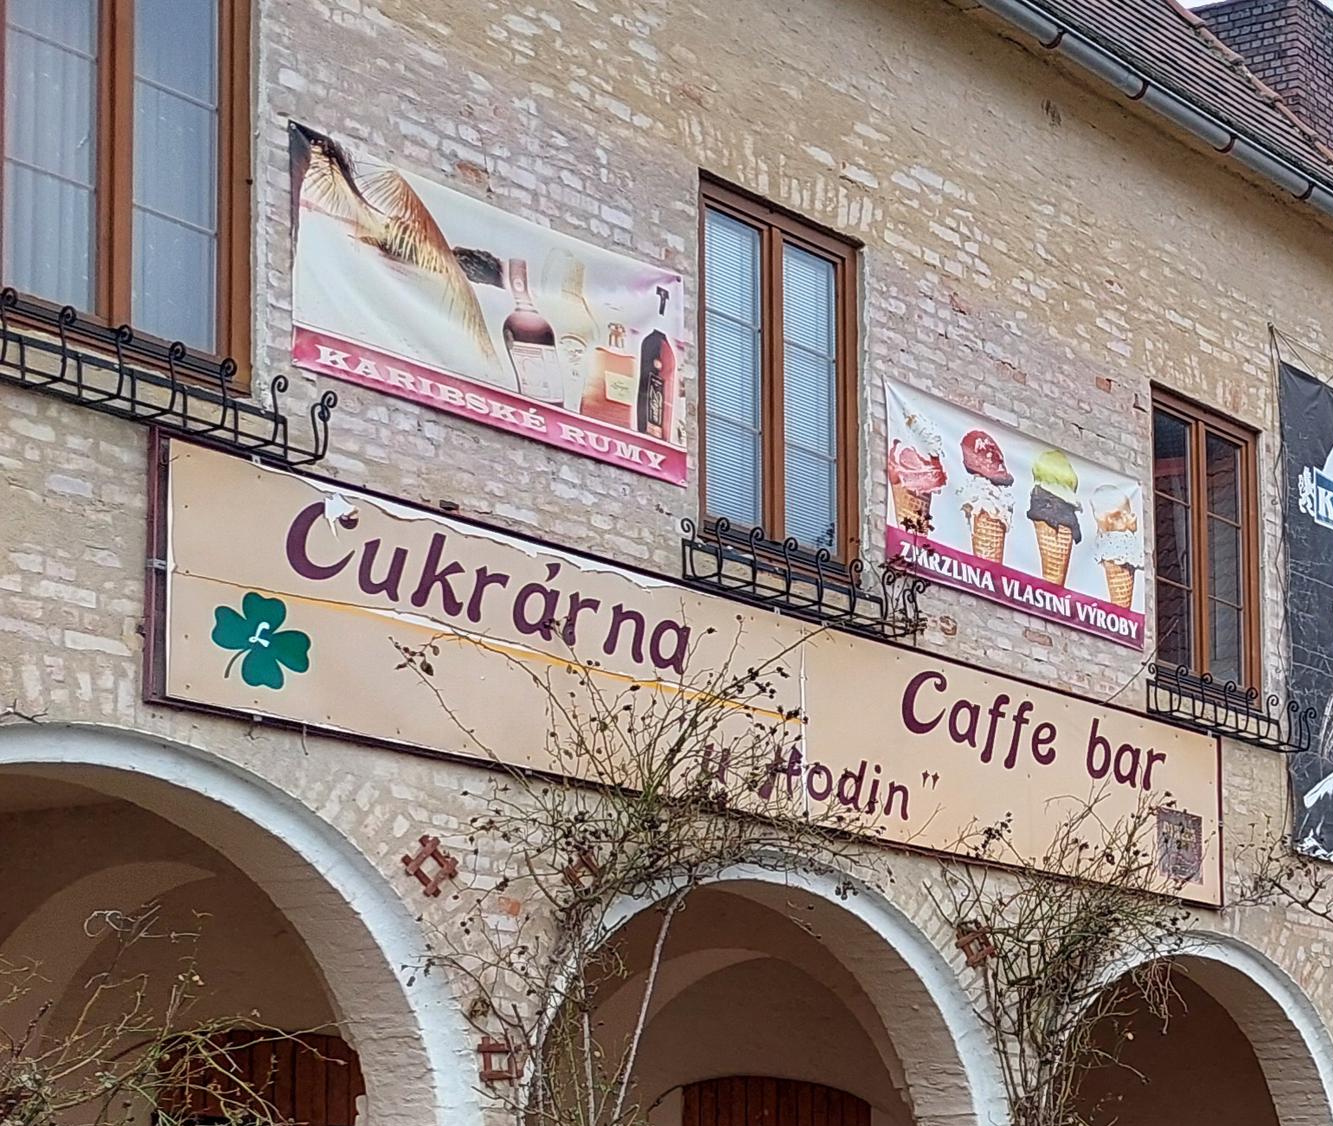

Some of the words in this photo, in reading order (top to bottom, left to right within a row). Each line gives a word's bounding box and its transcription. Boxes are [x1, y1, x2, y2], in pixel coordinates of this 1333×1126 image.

[315, 344, 548, 434] KARIBSKÉ
[556, 421, 667, 472] RUMY
[286, 499, 692, 676] Cukrárna
[899, 541, 995, 593] ZMRZLINA
[1000, 575, 1073, 618] VLASTNÍ
[1075, 600, 1140, 640] VÝROBY
[901, 670, 1058, 770] Caffe
[1086, 717, 1167, 791] bar
